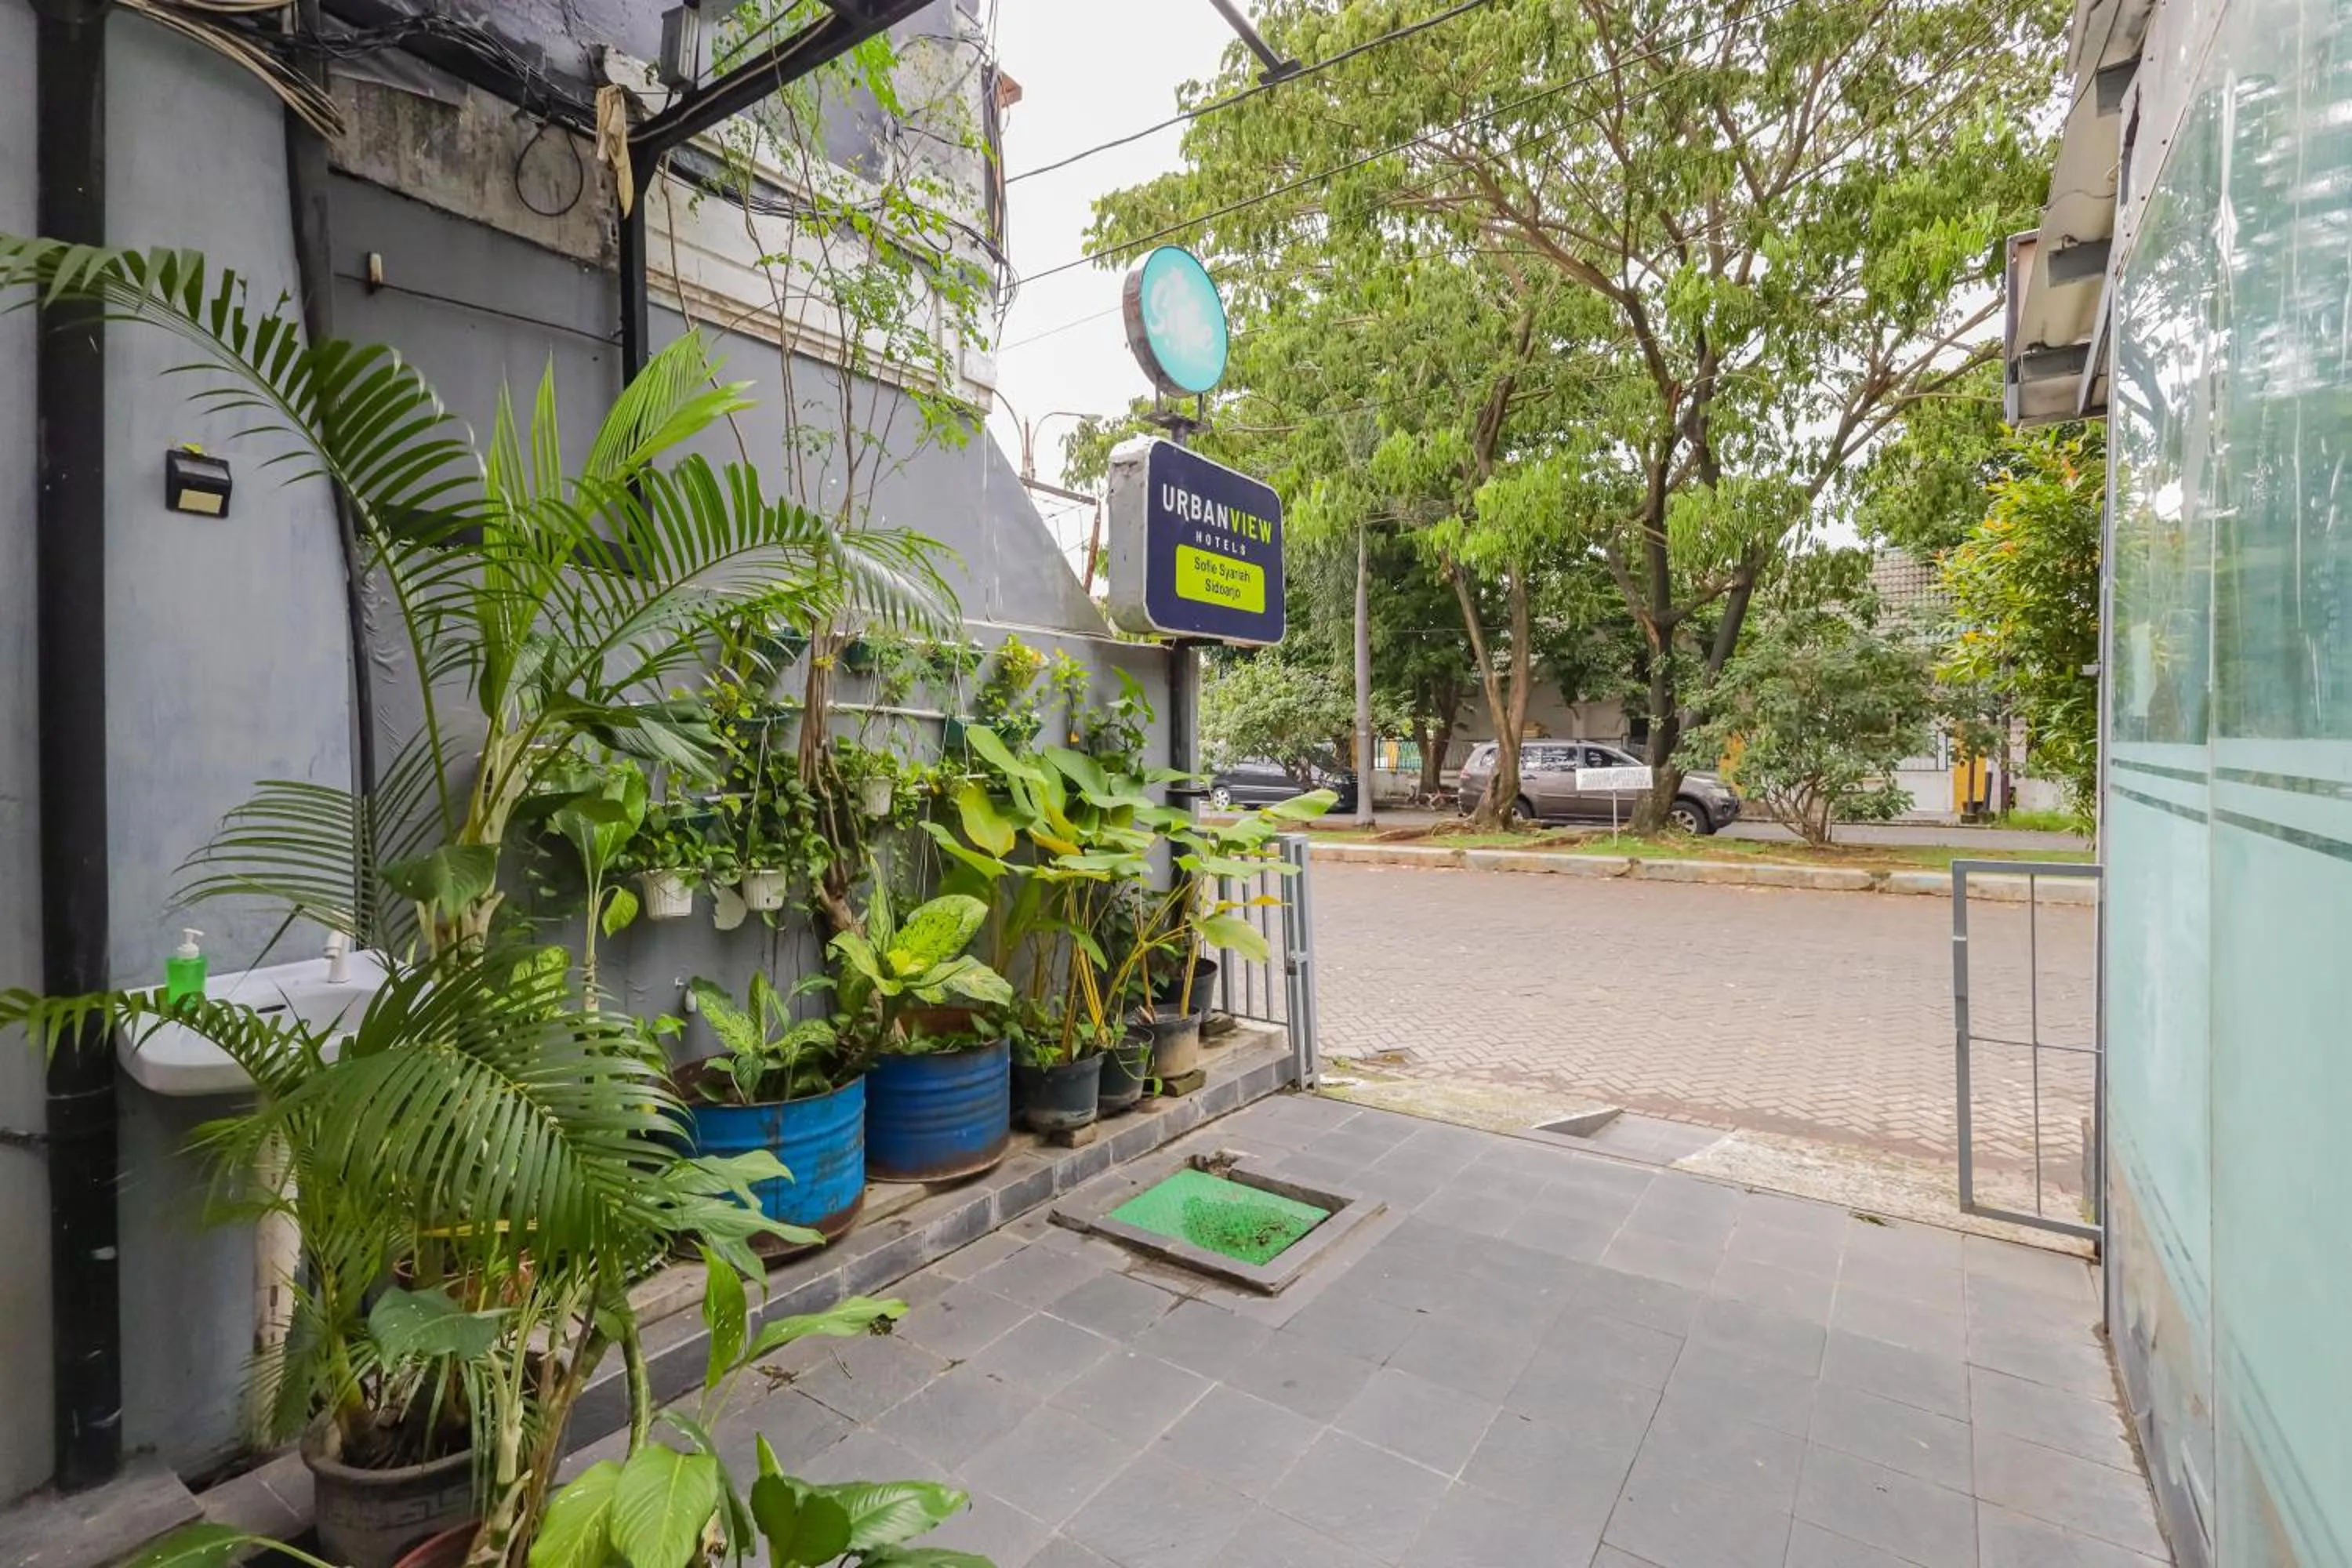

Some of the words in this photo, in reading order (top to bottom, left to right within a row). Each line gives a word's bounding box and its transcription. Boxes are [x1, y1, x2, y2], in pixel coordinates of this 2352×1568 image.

[1163, 483, 1272, 544] URBANVIEW
[1196, 531, 1246, 556] HOTELS
[1194, 557, 1218, 573] Sofie
